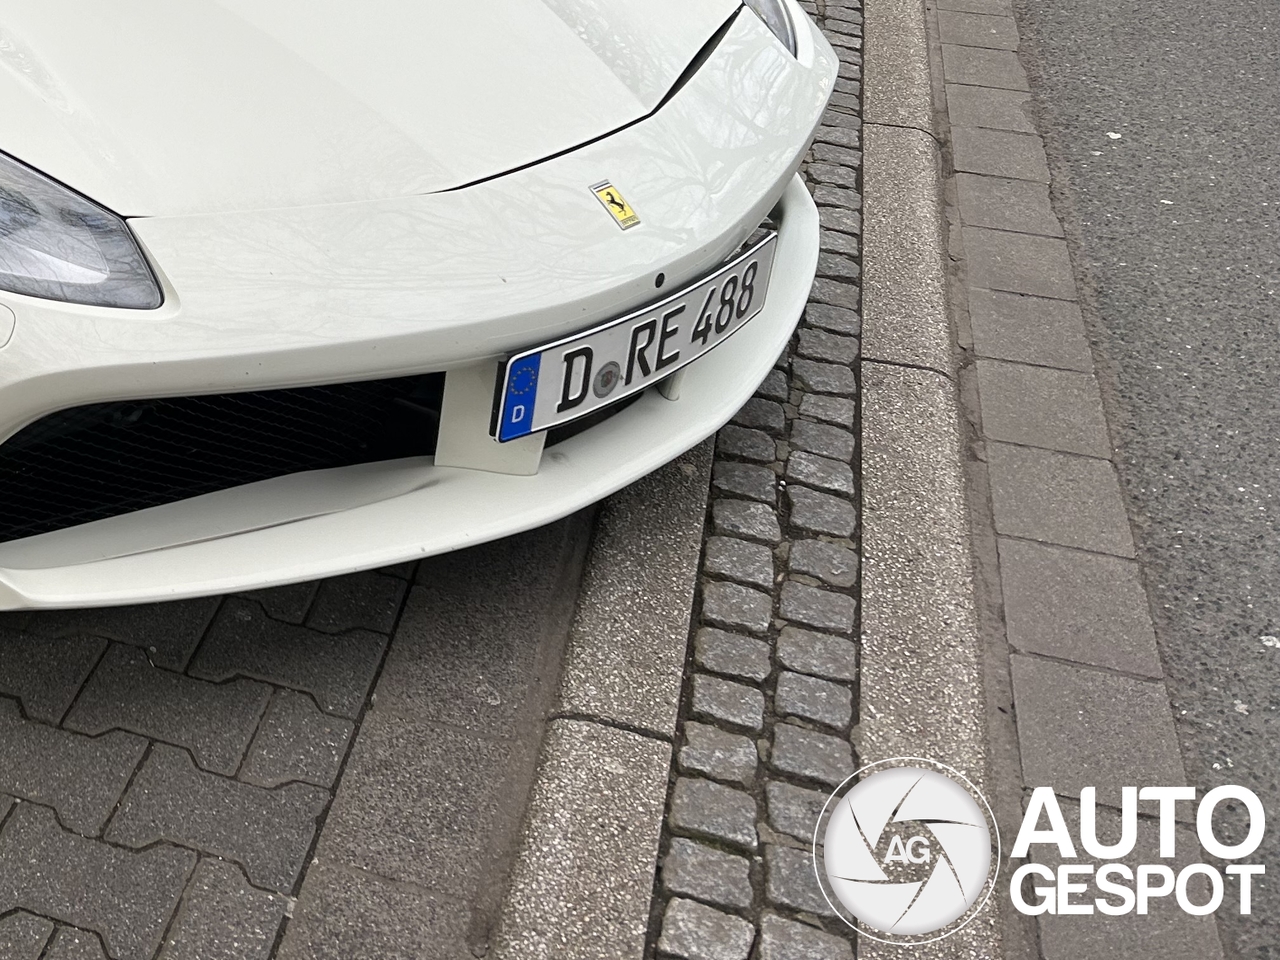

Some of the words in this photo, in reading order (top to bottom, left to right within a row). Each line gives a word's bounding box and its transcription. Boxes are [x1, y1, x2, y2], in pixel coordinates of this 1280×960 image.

[512, 404, 525, 423] D
[557, 346, 595, 414] D
[624, 303, 687, 386] RE
[690, 259, 759, 346] 488
